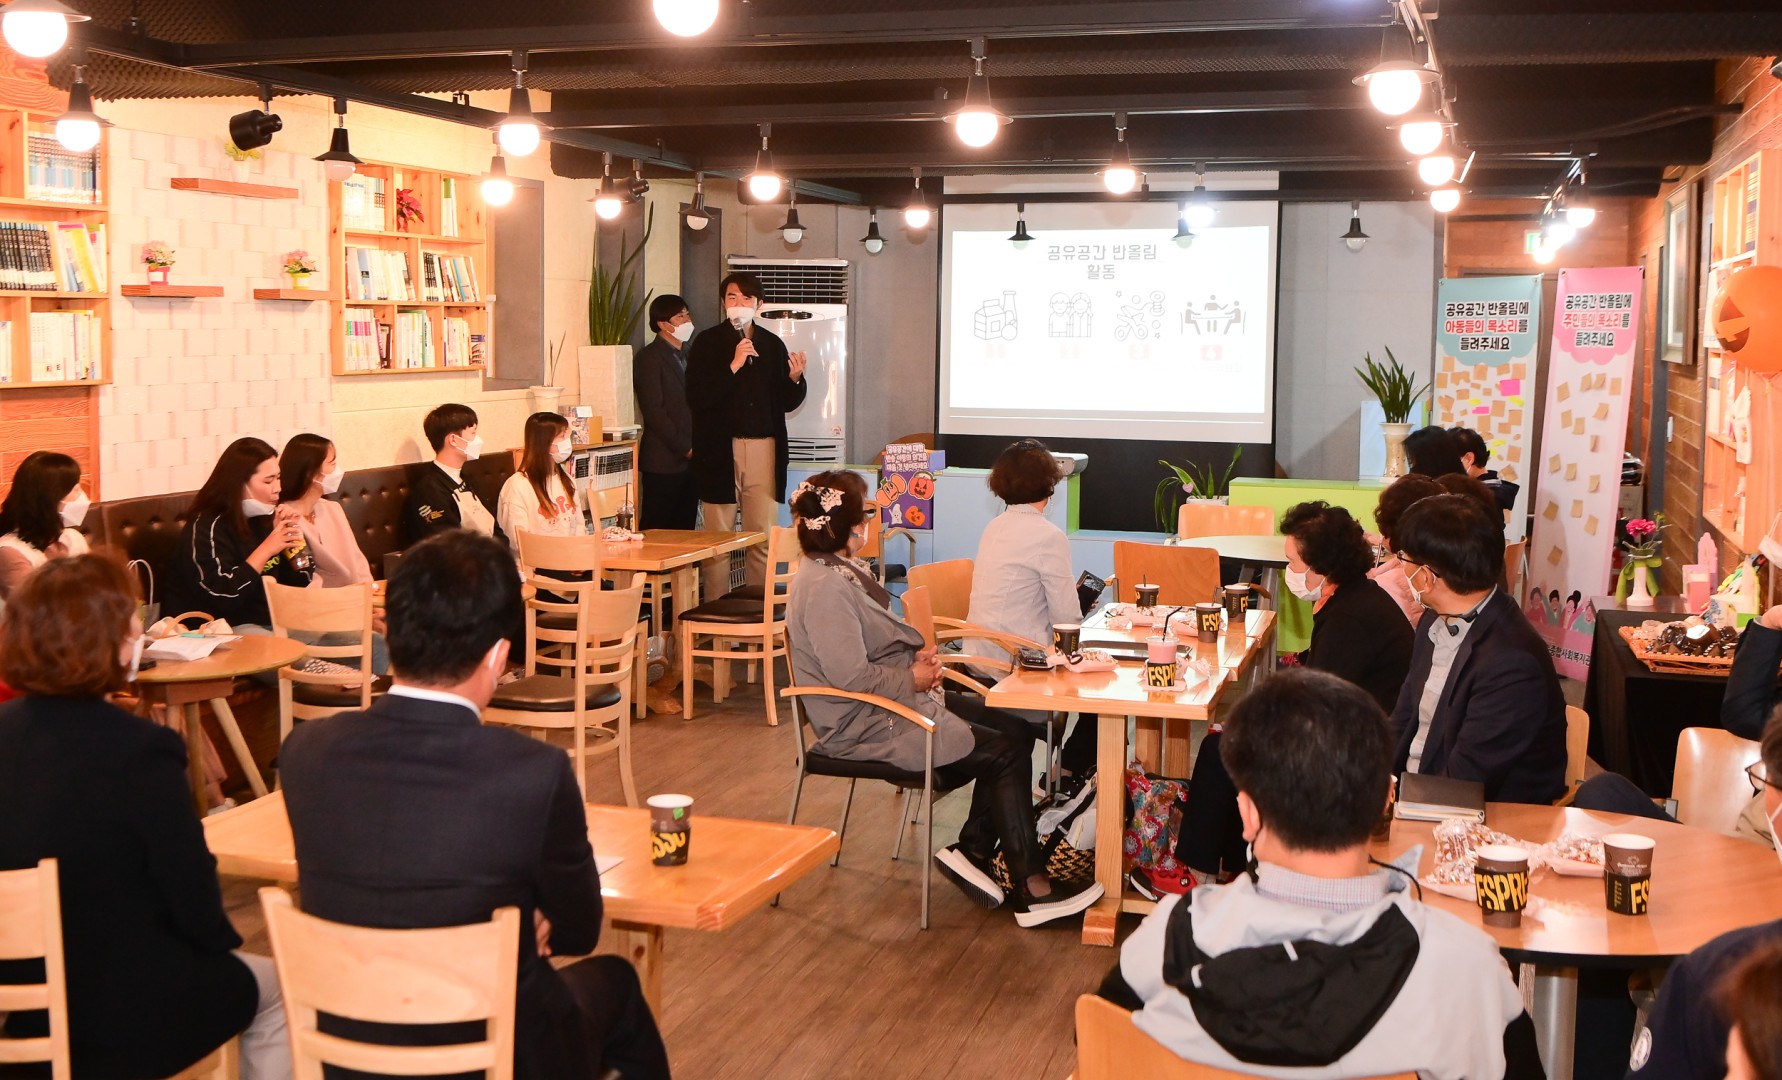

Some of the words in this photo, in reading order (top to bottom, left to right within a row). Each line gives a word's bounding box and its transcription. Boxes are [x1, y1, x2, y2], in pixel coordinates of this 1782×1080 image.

[1047, 245, 1107, 260] 공유공간
[1112, 244, 1157, 260] 반올림
[1087, 264, 1115, 280] 활동
[1446, 302, 1486, 317] 공유공간
[1487, 301, 1529, 316] 반올림에
[1565, 294, 1597, 310] 공유공간
[1599, 294, 1632, 309] 반올림에
[1445, 320, 1485, 334] 아동들의
[1487, 319, 1528, 333] 목소리를
[1563, 313, 1596, 328] 주민들의
[1598, 313, 1630, 328] 목소리를
[1460, 336, 1510, 350] 들려주세요
[1575, 332, 1614, 346] 들려주세요
